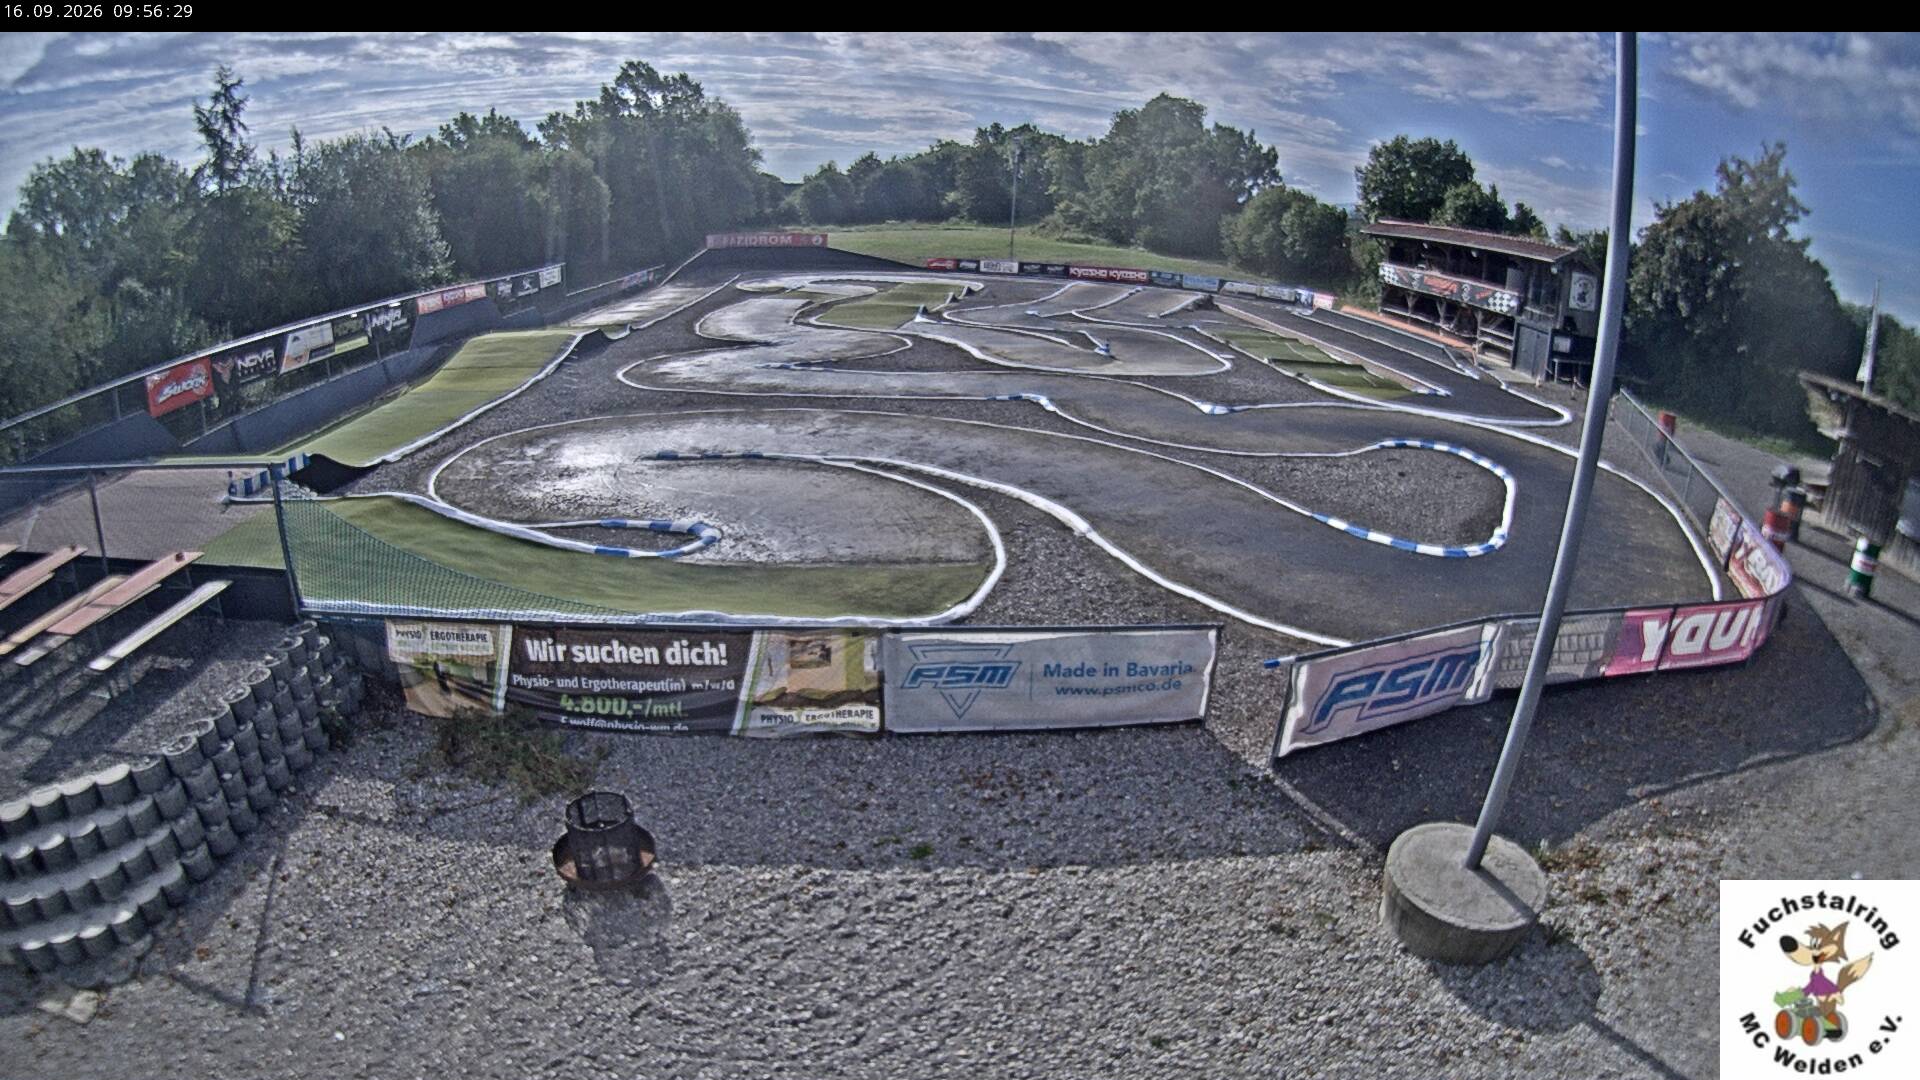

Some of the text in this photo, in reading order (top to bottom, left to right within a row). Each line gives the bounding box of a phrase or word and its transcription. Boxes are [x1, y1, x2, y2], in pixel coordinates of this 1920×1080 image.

[429, 630, 488, 643] ERGOTHERAPIE
[525, 638, 729, 666] Wir suchen dich!
[905, 665, 1015, 685] PSM
[1043, 660, 1194, 678] Made in Bavaria
[512, 674, 554, 690] Physio-
[556, 677, 579, 688] und
[581, 678, 687, 693] Ergotherapeut(in)
[1055, 677, 1182, 698] www.psmco.de
[1312, 648, 1490, 727] PSM
[760, 713, 794, 724] PHYSIO
